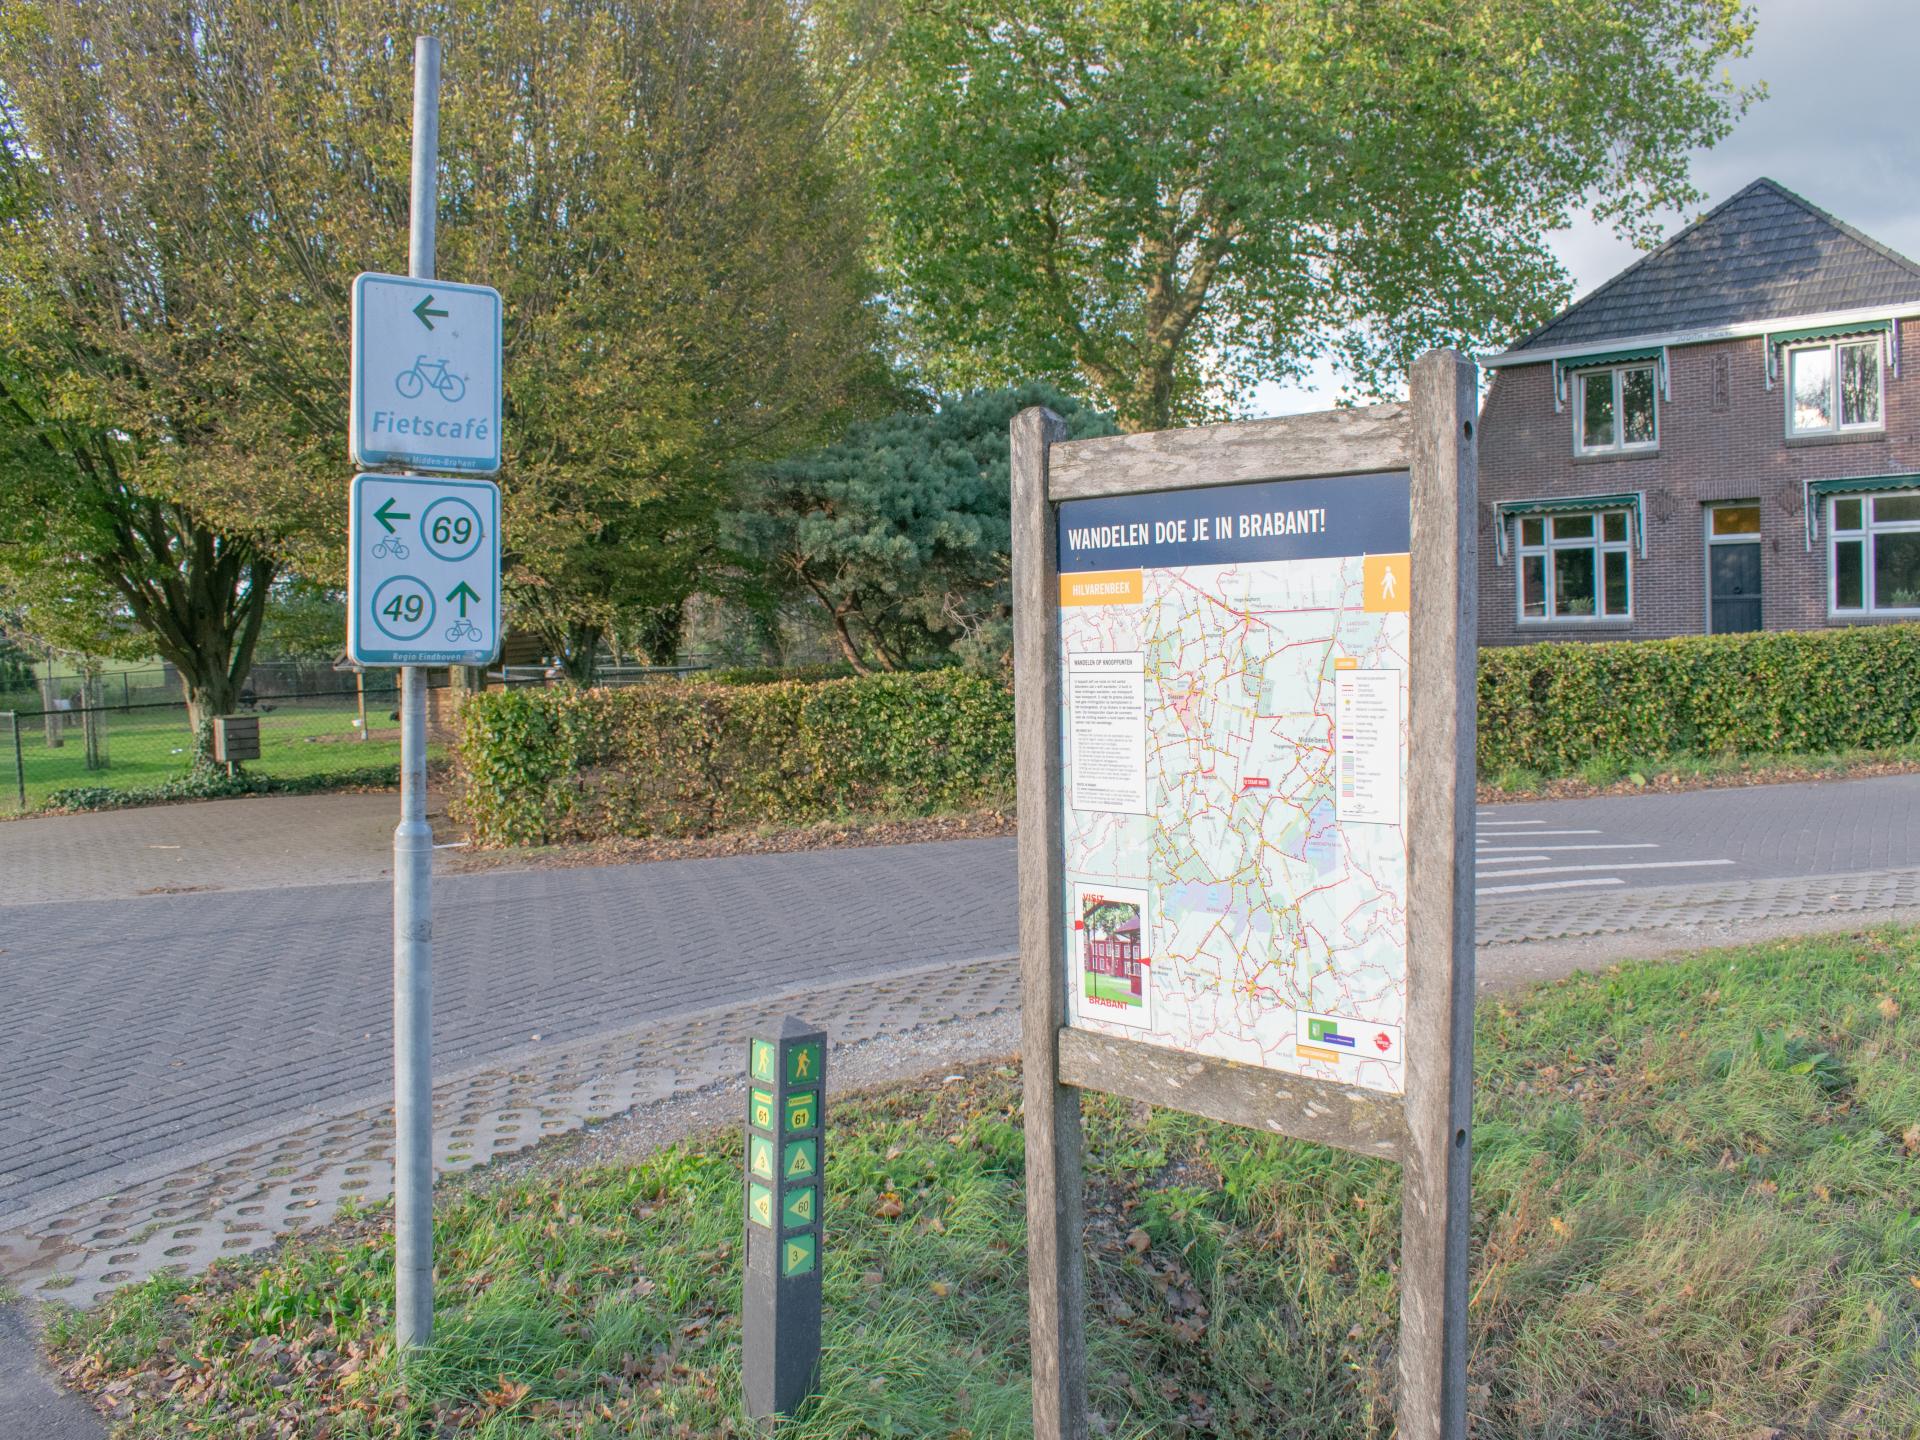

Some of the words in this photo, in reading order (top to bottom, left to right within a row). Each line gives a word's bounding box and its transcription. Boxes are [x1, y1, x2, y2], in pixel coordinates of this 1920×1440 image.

[372, 411, 488, 440] Fietscafé
[432, 516, 472, 544] 69
[1068, 523, 1149, 550] WANDELEN
[1155, 520, 1187, 544] DOE
[1192, 518, 1209, 541] JE
[1216, 516, 1232, 540] IN
[1239, 508, 1326, 538] BRABANT!
[1072, 581, 1131, 596] HILVARENBEEK
[383, 594, 424, 623] 49
[392, 652, 416, 662] Regio
[418, 653, 461, 661] Eindhoven
[1082, 892, 1105, 904] VISIT
[1088, 996, 1128, 1010] BRABANT
[758, 1110, 767, 1123] 61
[795, 1112, 806, 1125] 61
[760, 1156, 765, 1168] 3
[794, 1158, 806, 1170] 42
[759, 1200, 768, 1215] 42
[798, 1200, 809, 1213] 60
[792, 1251, 798, 1262] 3
